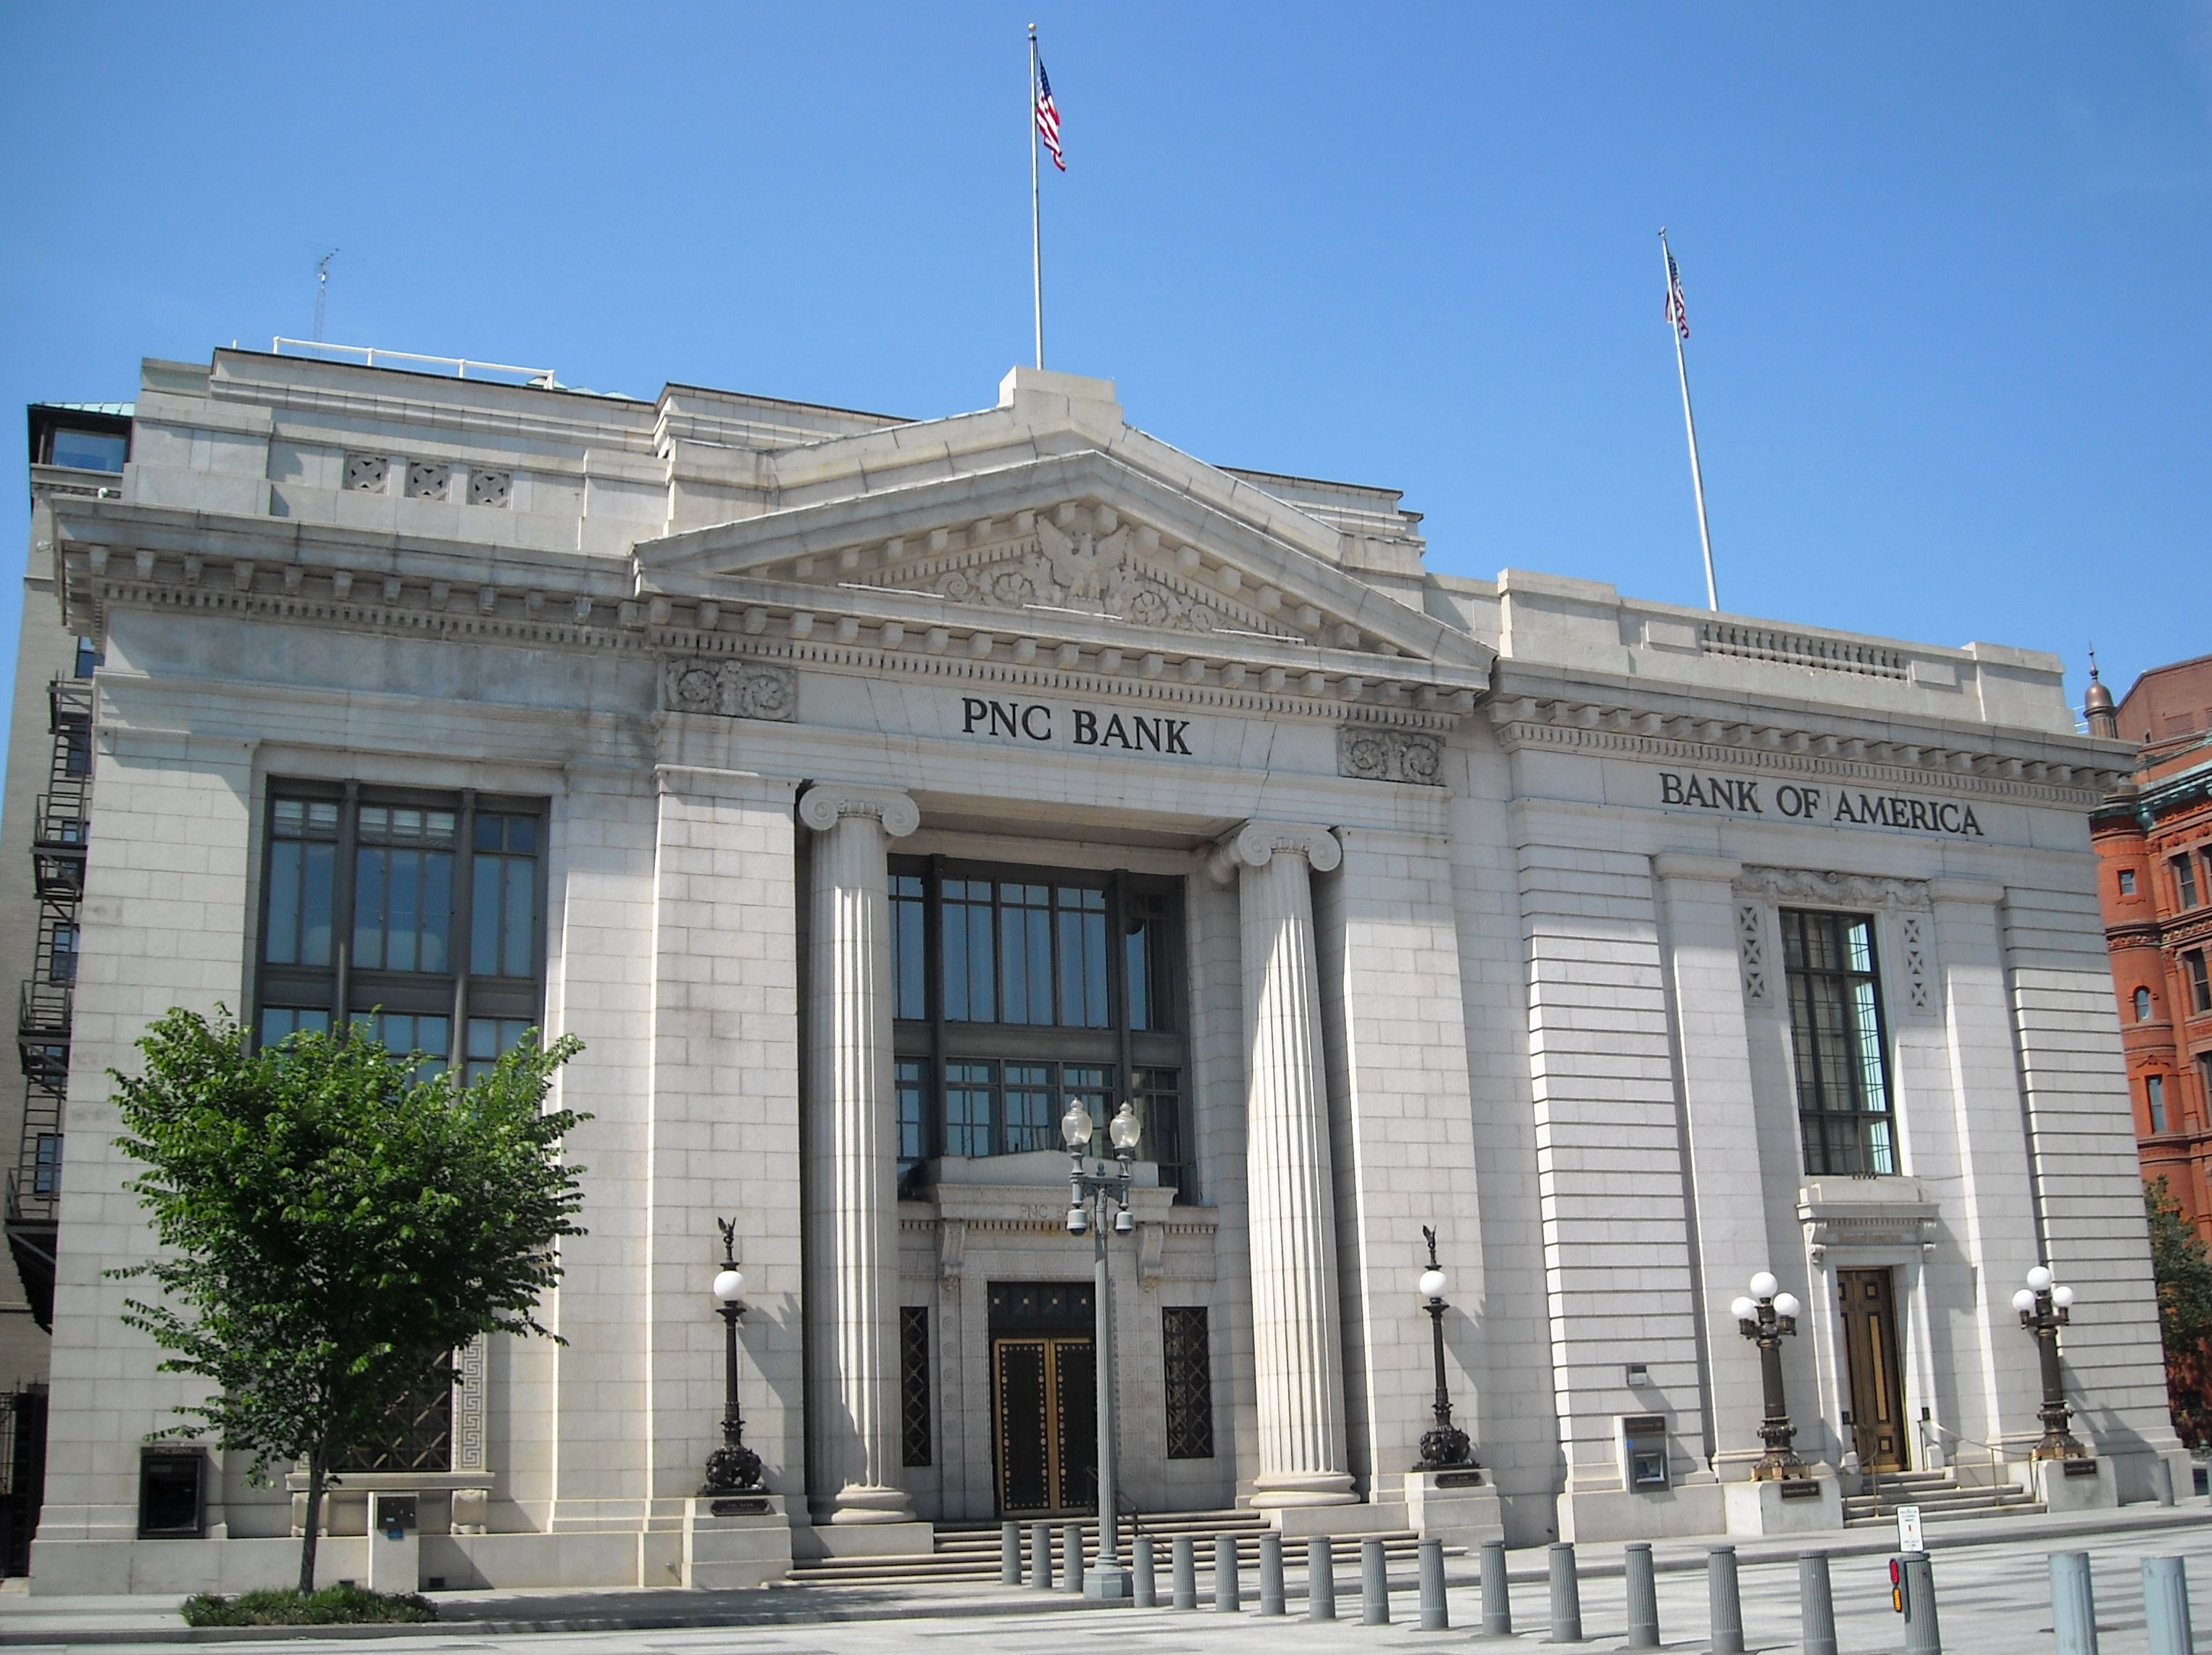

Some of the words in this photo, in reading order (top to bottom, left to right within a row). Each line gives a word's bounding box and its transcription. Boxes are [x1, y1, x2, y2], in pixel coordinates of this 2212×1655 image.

[961, 697, 1051, 741] PNC
[1072, 709, 1192, 755] BANK
[1659, 772, 1763, 813] BANK
[1776, 785, 1820, 818] OF
[1834, 790, 1984, 835] AMERICA
[1020, 1204, 1048, 1218] PNC
